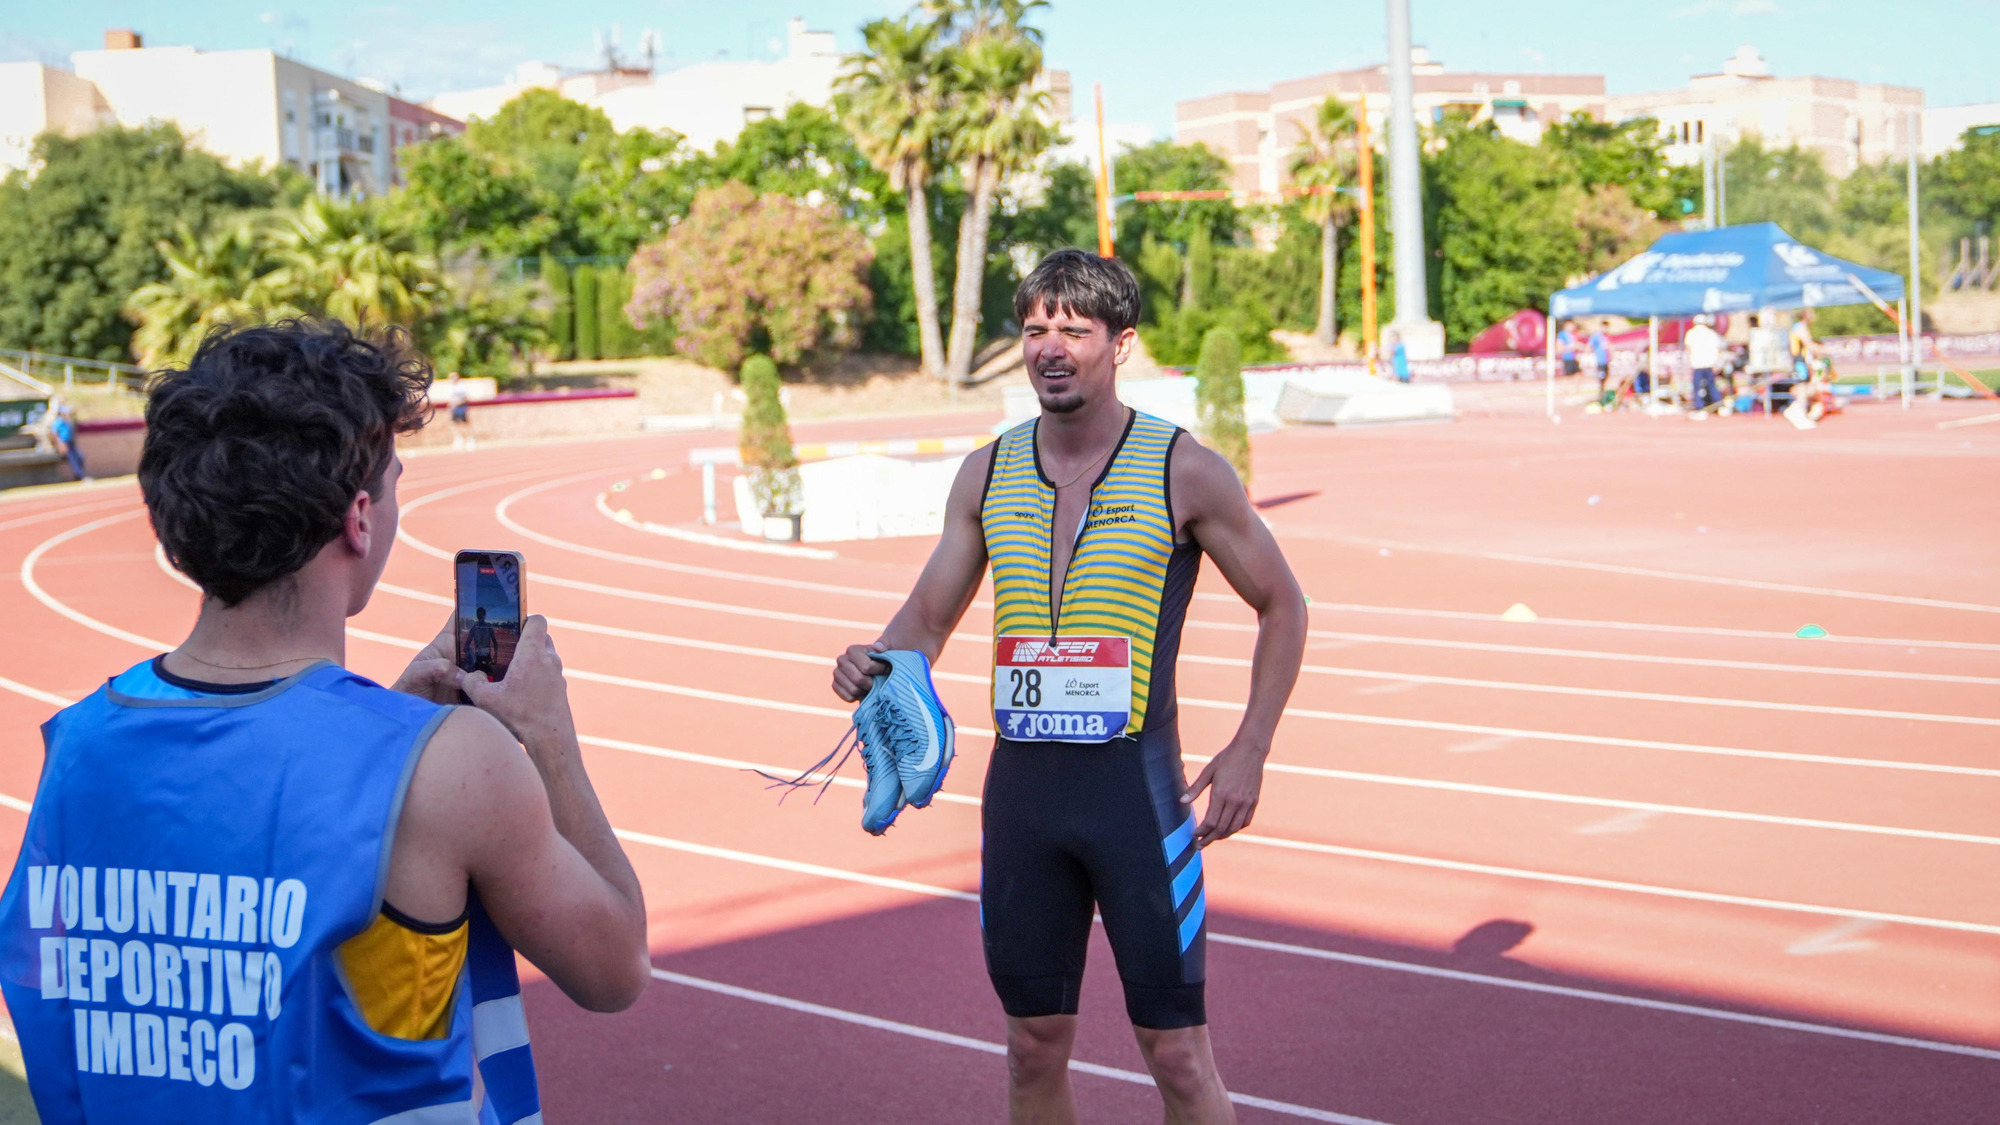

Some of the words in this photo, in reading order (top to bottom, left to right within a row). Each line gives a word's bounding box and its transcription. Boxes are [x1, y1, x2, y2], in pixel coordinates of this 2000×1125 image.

[1086, 514, 1136, 530] MENORCA
[1106, 503, 1135, 515] Esport
[1041, 641, 1100, 656] RFEA
[1010, 669, 1041, 707] 28
[28, 864, 307, 948] VOLUNTARIO
[40, 936, 282, 1021] DEPORTIVO
[74, 1008, 255, 1090] IMDECO
